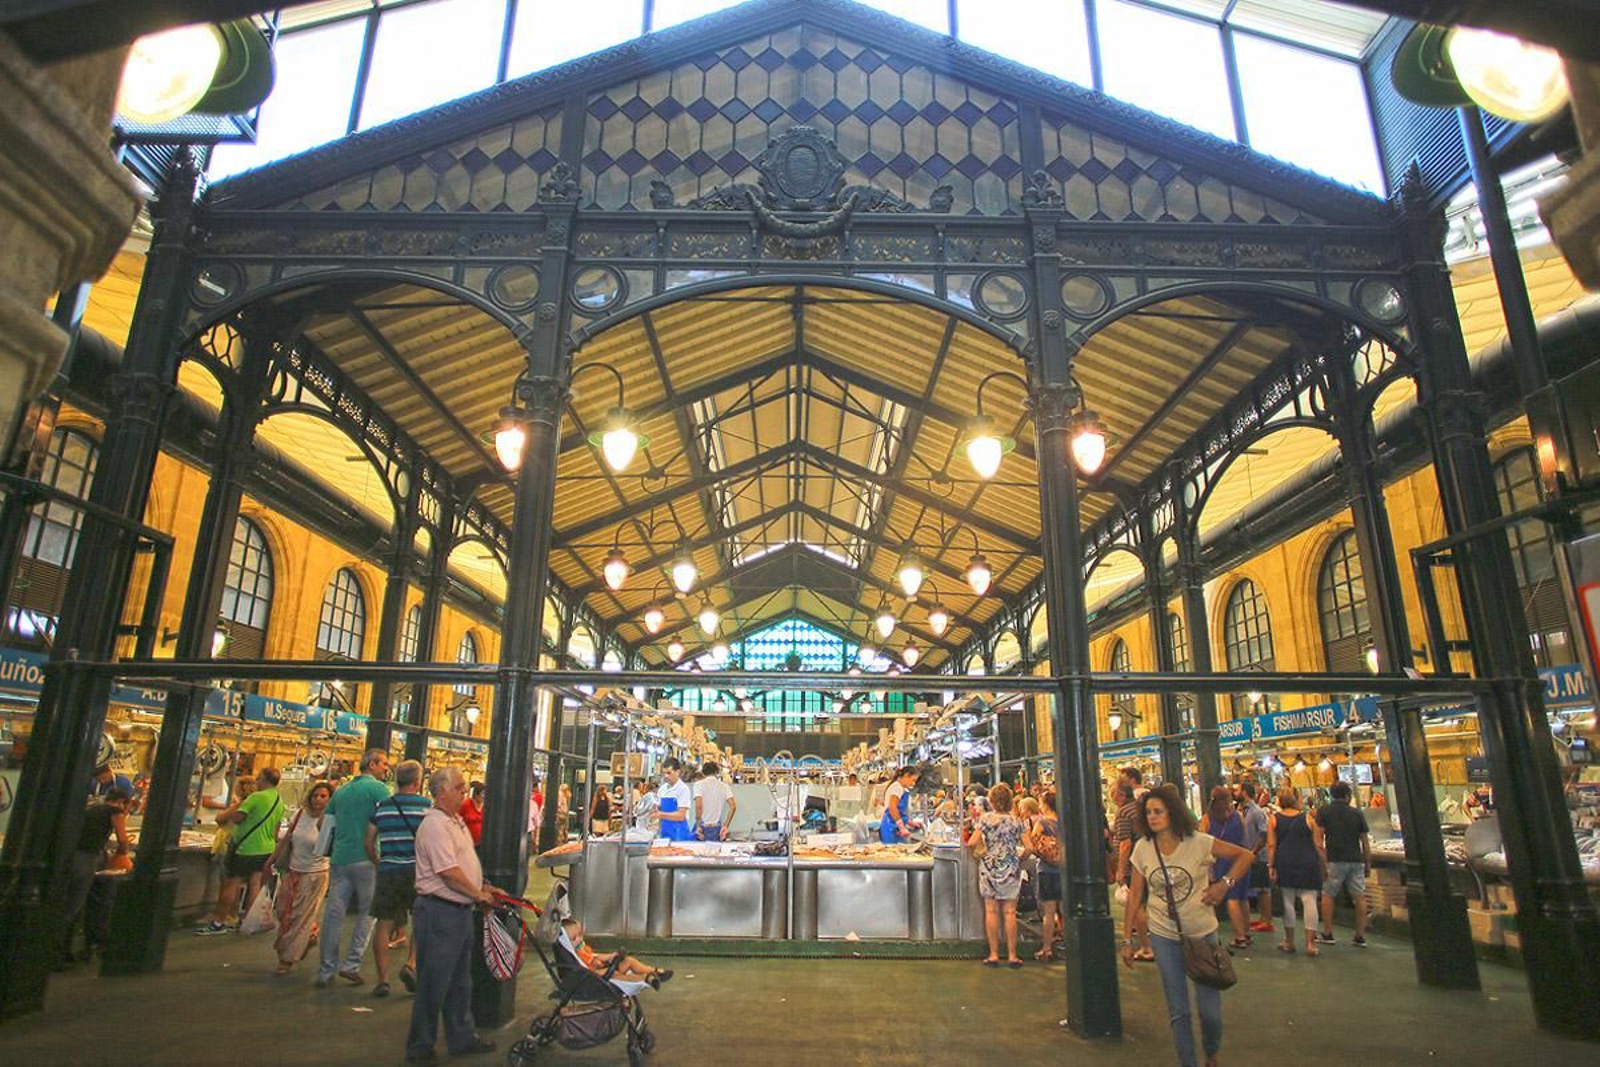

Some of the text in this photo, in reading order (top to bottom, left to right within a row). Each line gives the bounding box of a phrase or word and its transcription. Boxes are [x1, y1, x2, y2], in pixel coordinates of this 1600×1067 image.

[223, 691, 241, 717] 15
[265, 701, 335, 731] M.Segura 16
[1273, 709, 1336, 732] FISHMARSUR
